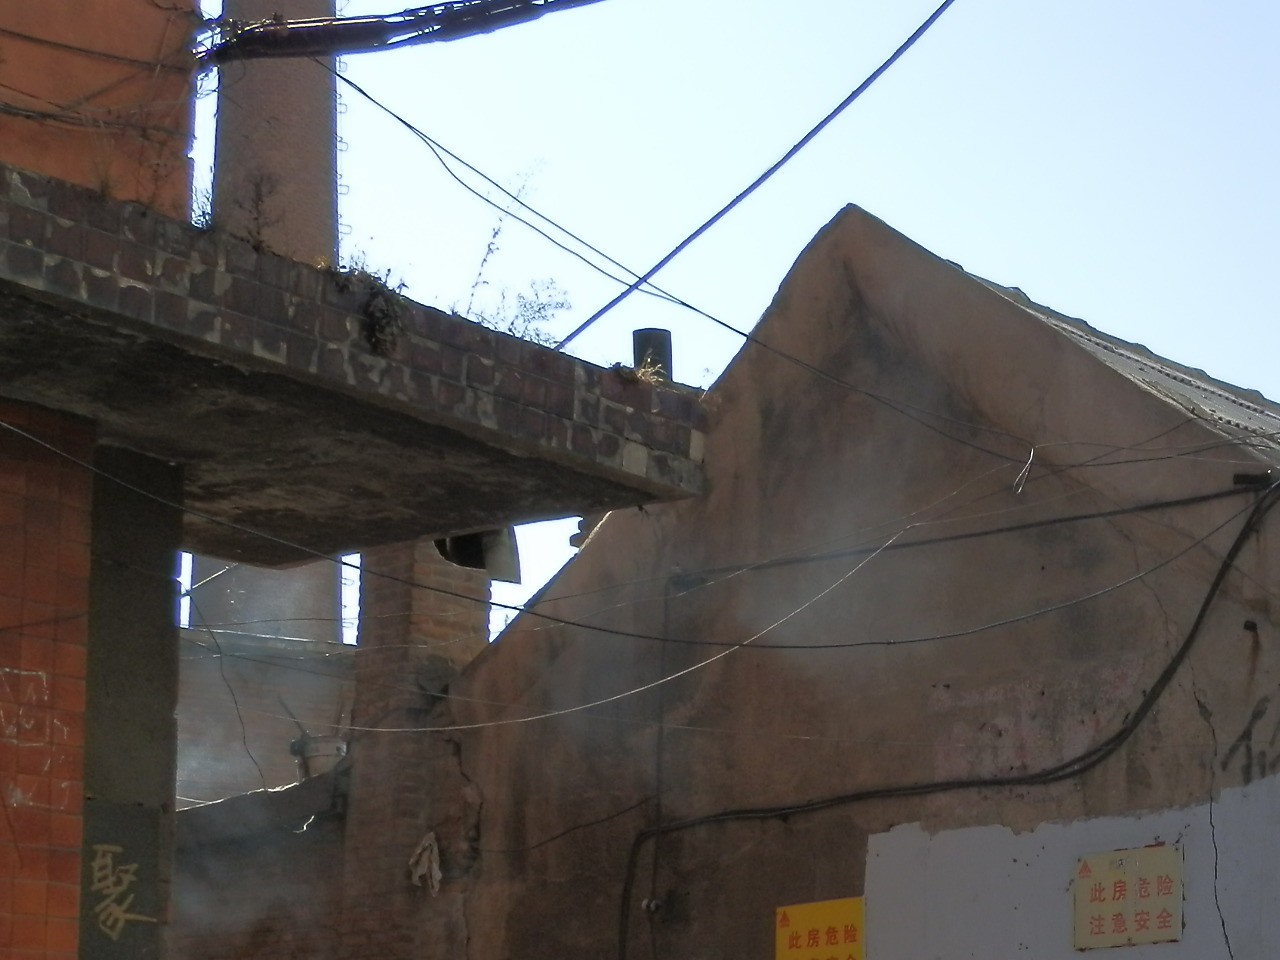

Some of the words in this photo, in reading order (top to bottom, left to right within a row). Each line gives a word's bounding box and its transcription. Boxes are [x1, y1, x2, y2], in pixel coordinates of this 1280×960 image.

[1089, 874, 1173, 903] 此房危险
[1089, 908, 1173, 936] 注意安全
[788, 924, 858, 951] 此房危险
